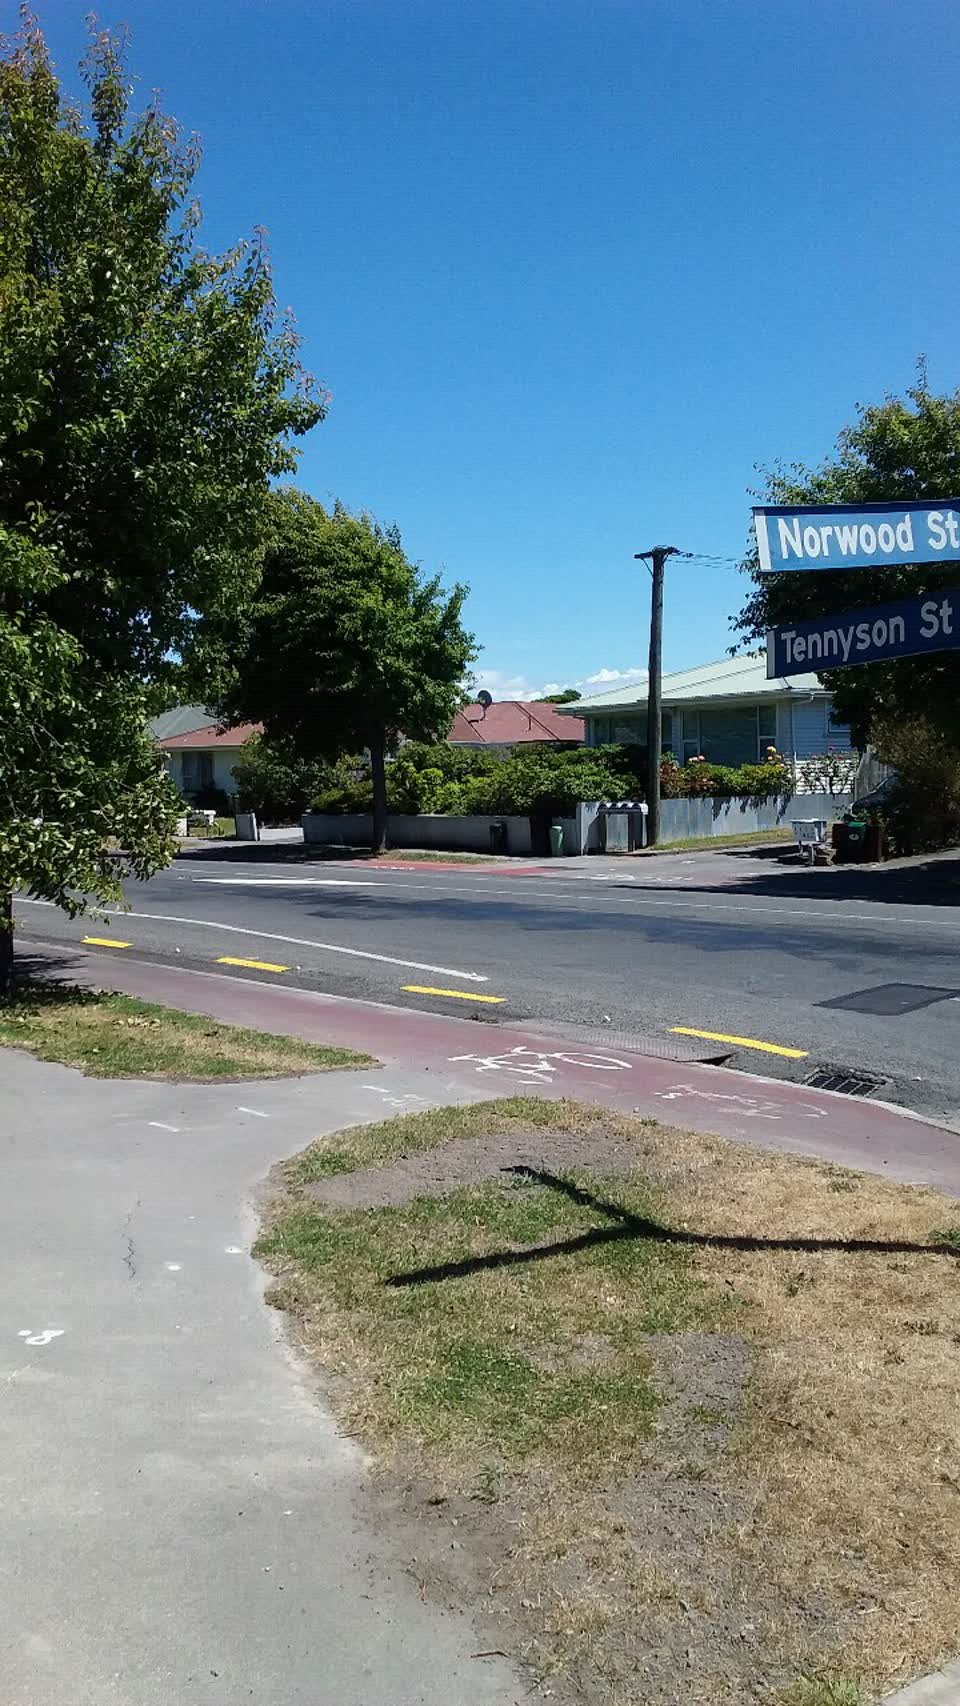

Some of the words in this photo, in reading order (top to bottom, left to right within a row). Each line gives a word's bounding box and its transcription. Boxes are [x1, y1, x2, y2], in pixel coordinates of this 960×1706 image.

[777, 514, 914, 559] Norwood
[927, 511, 960, 550] St
[781, 615, 905, 664] Tennyson
[919, 599, 953, 638] St
